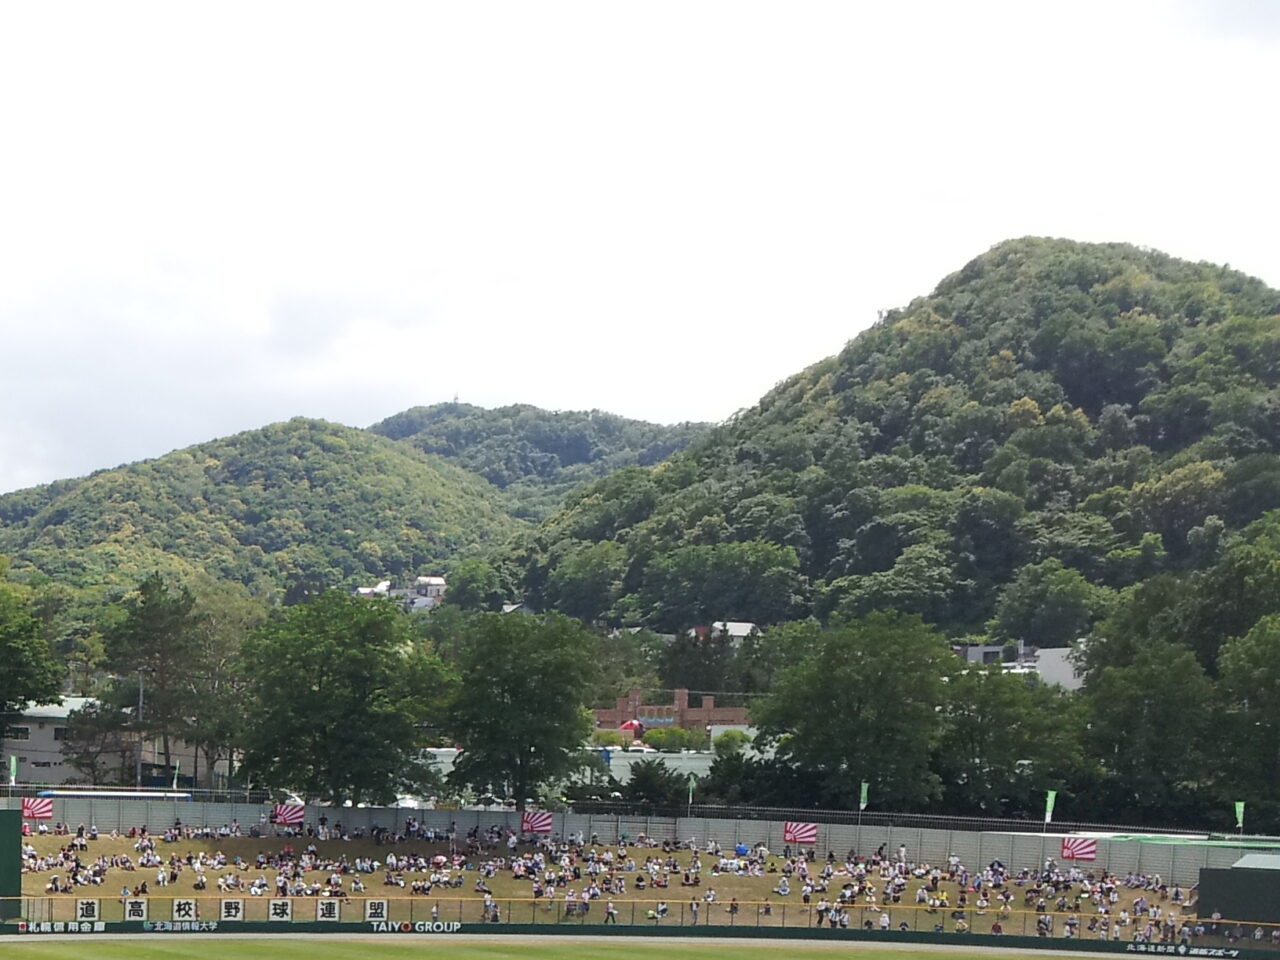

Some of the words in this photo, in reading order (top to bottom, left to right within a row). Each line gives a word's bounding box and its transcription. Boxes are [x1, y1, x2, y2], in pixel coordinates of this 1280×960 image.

[80, 901, 384, 918] 道高校野球連盟
[154, 922, 218, 931] 北海道情報大学
[371, 921, 412, 933] TAIYO
[414, 922, 462, 933] GROUP
